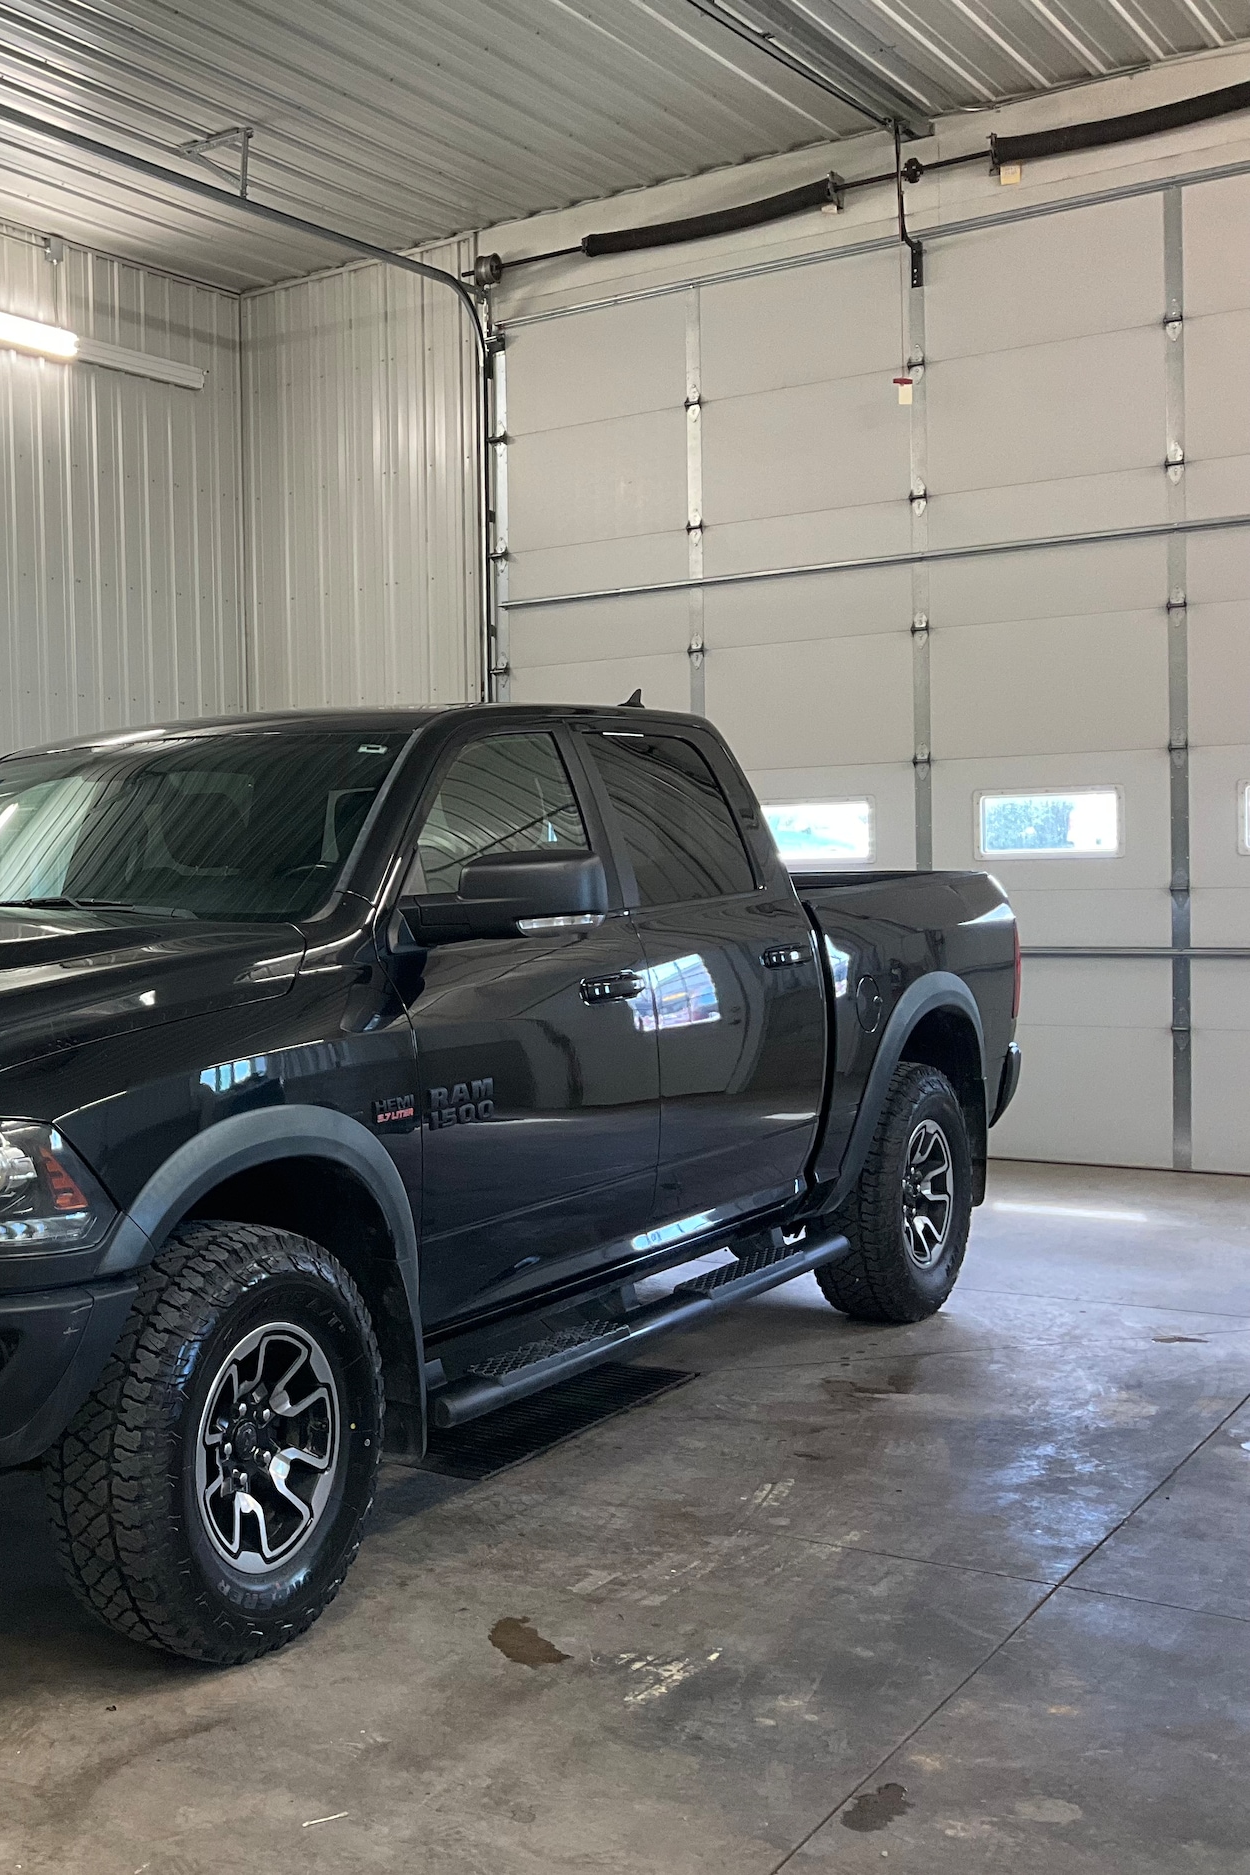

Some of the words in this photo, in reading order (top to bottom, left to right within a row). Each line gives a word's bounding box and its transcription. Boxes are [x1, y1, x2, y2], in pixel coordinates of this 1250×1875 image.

[374, 1094, 415, 1112] HEMI
[429, 1077, 495, 1109] RAM
[429, 1099, 495, 1130] 1500
